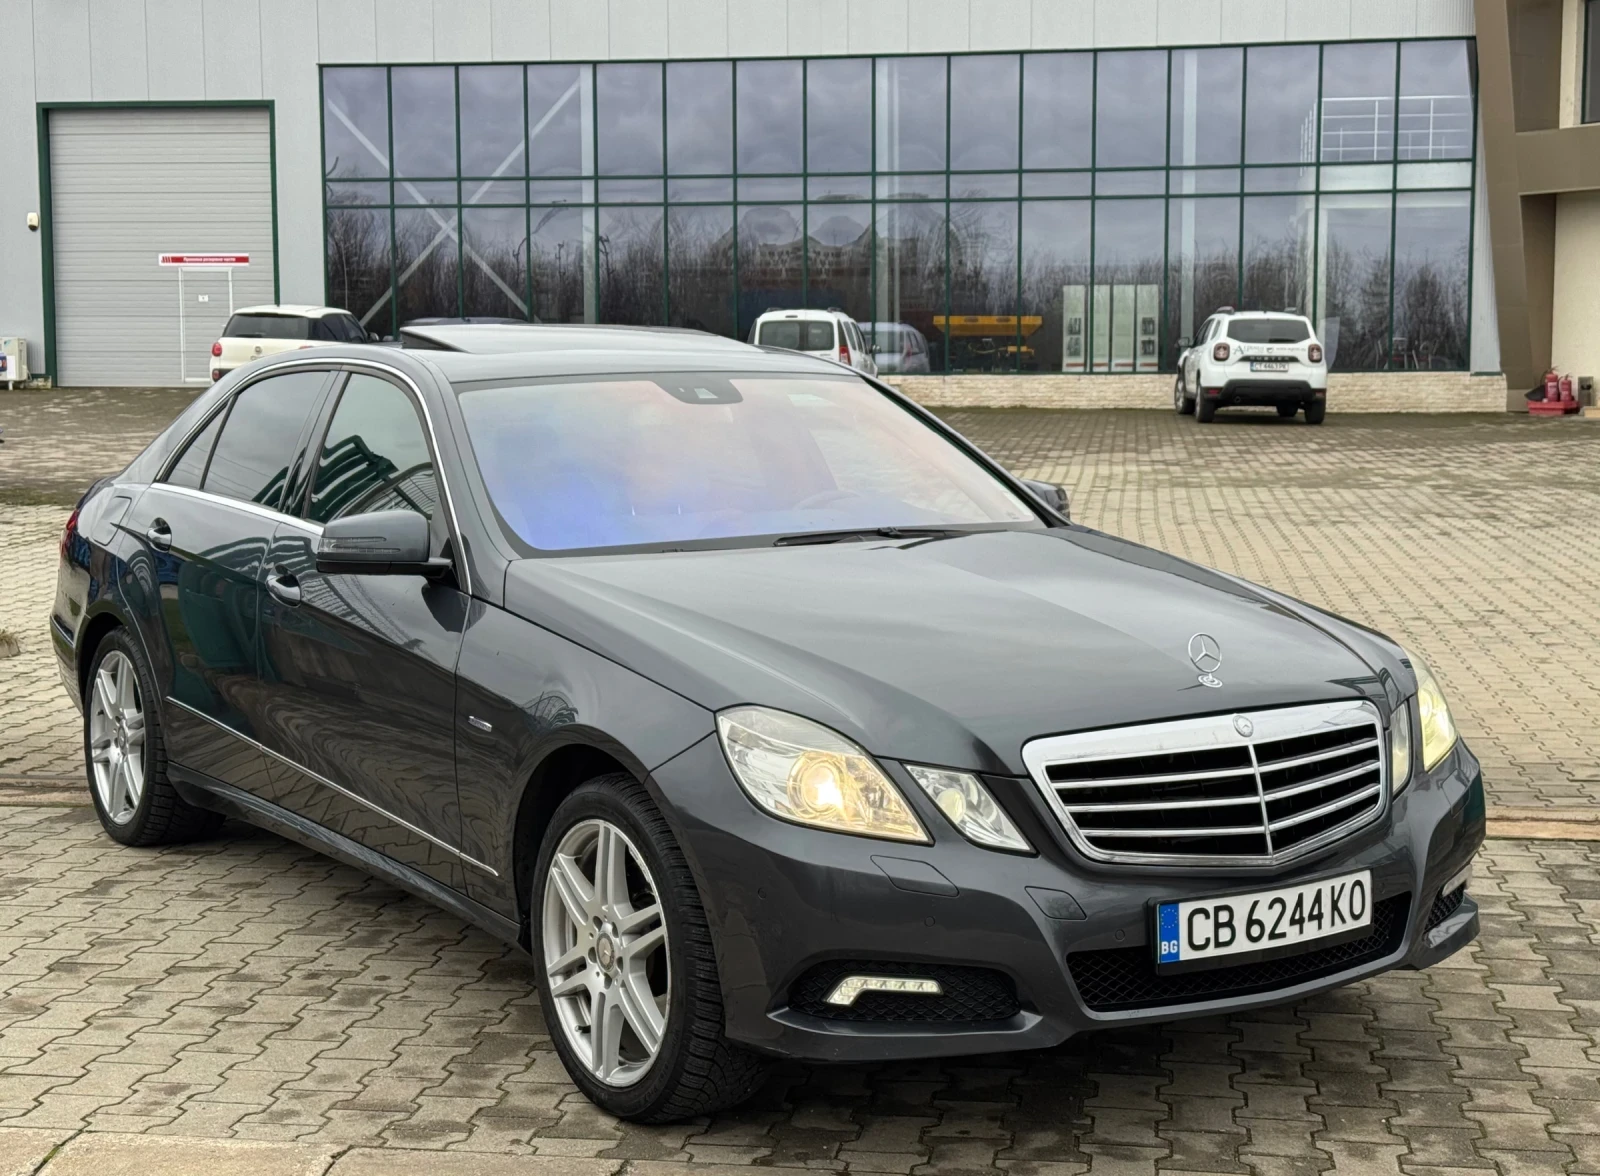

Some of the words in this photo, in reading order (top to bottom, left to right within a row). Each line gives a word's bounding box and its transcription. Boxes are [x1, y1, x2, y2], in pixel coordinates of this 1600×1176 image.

[1187, 904, 1237, 952] CB
[1245, 888, 1324, 943] 6244
[1330, 879, 1366, 928] KO
[1161, 940, 1178, 955] BG
